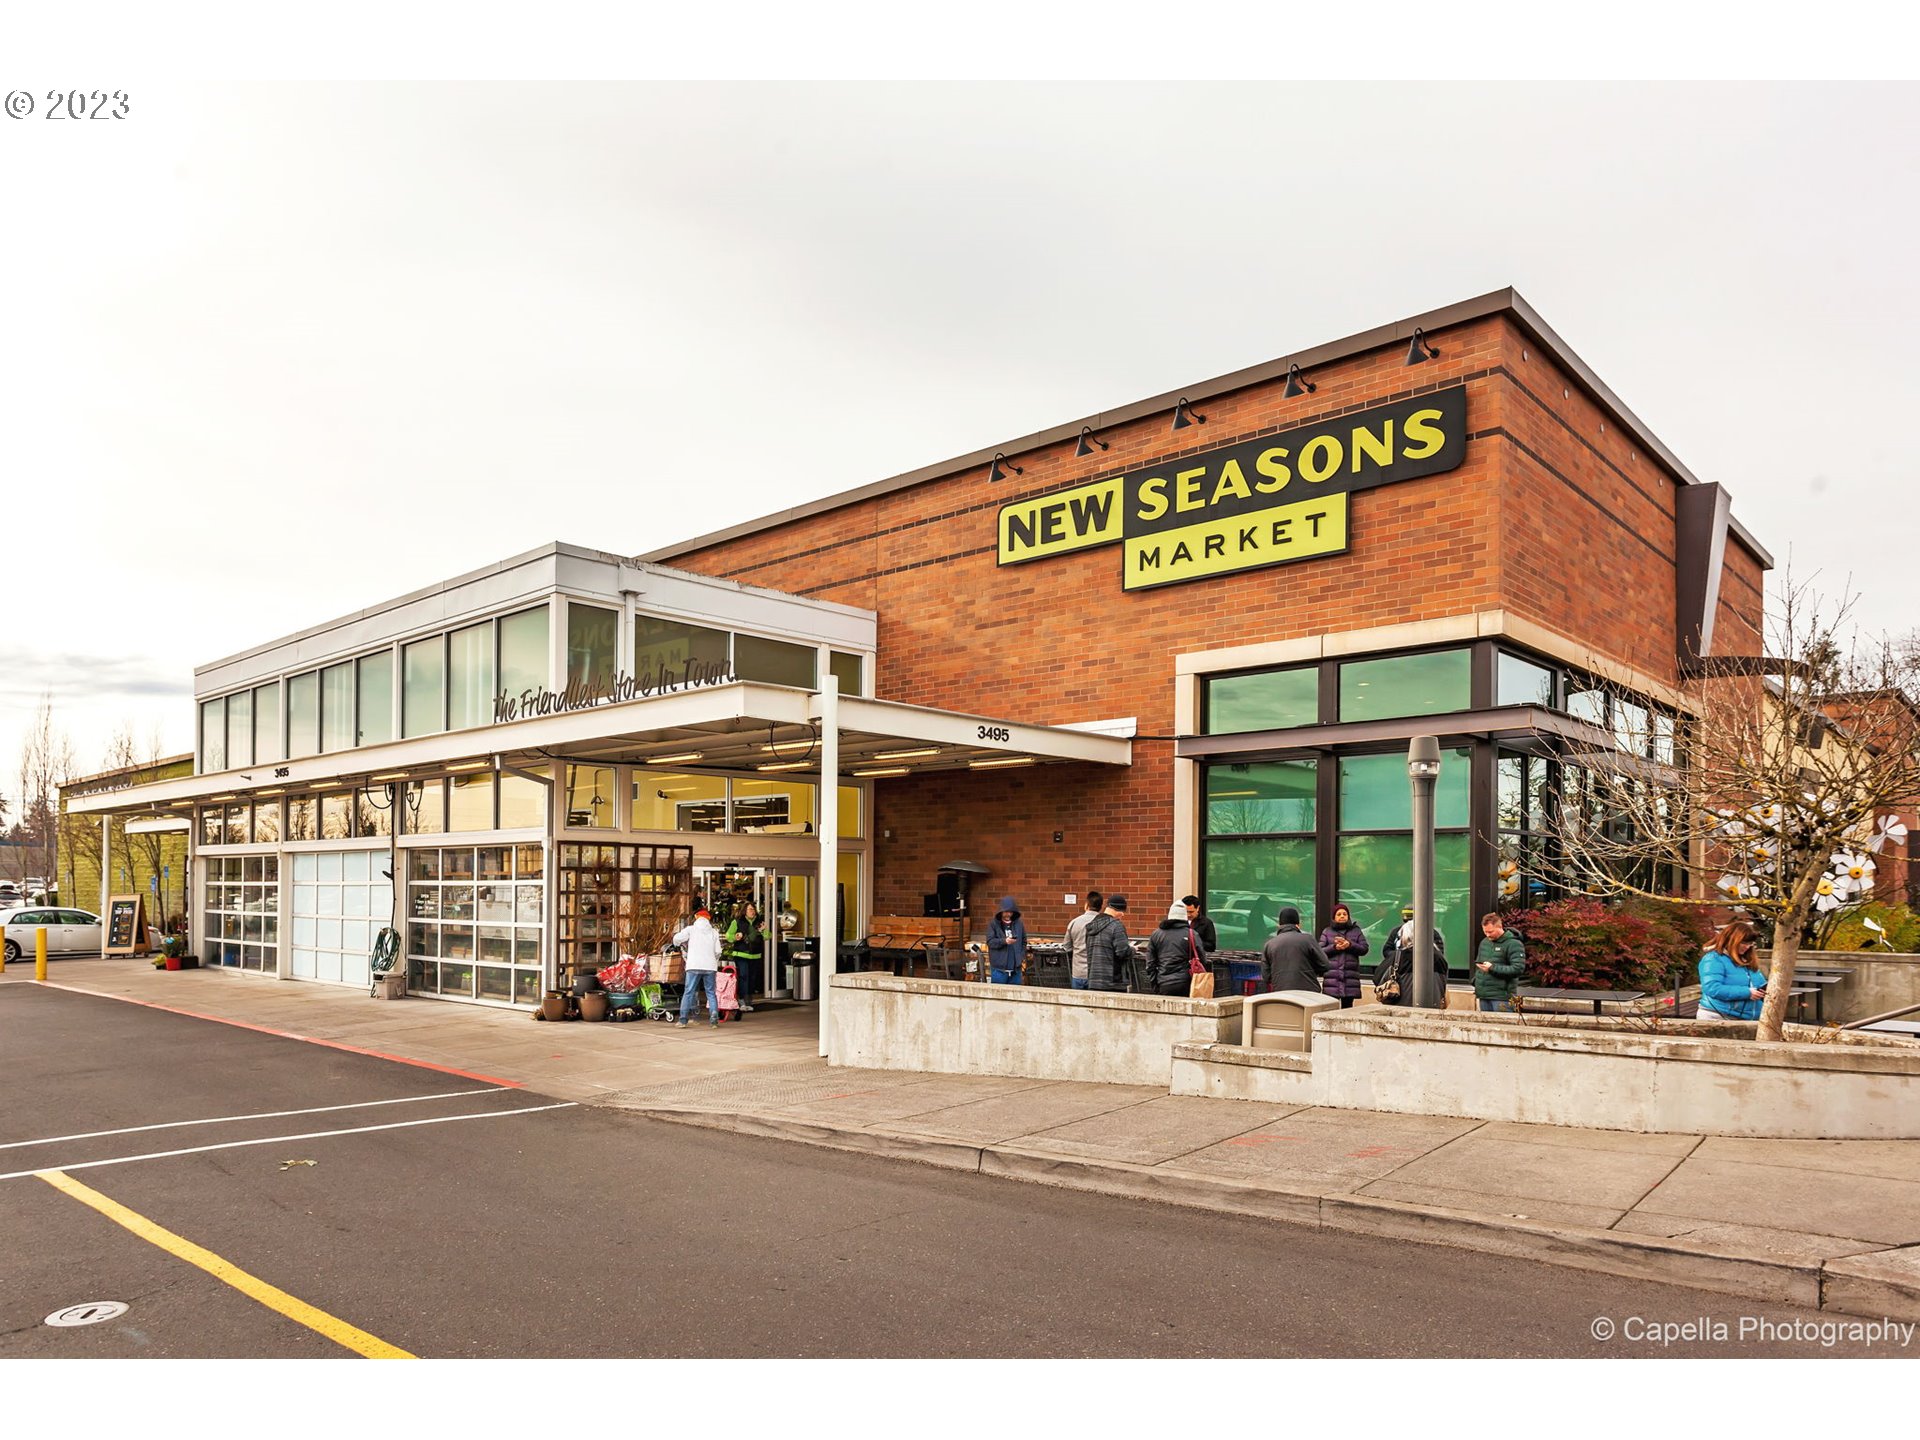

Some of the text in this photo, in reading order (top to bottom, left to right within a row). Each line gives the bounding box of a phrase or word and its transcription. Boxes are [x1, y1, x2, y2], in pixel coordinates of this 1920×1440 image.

[1008, 408, 1446, 552] NEW SEASONS
[1139, 511, 1326, 573] MARKET
[493, 688, 517, 723] The
[607, 669, 652, 703] Store
[658, 663, 677, 695] In
[977, 725, 1010, 742] 3495
